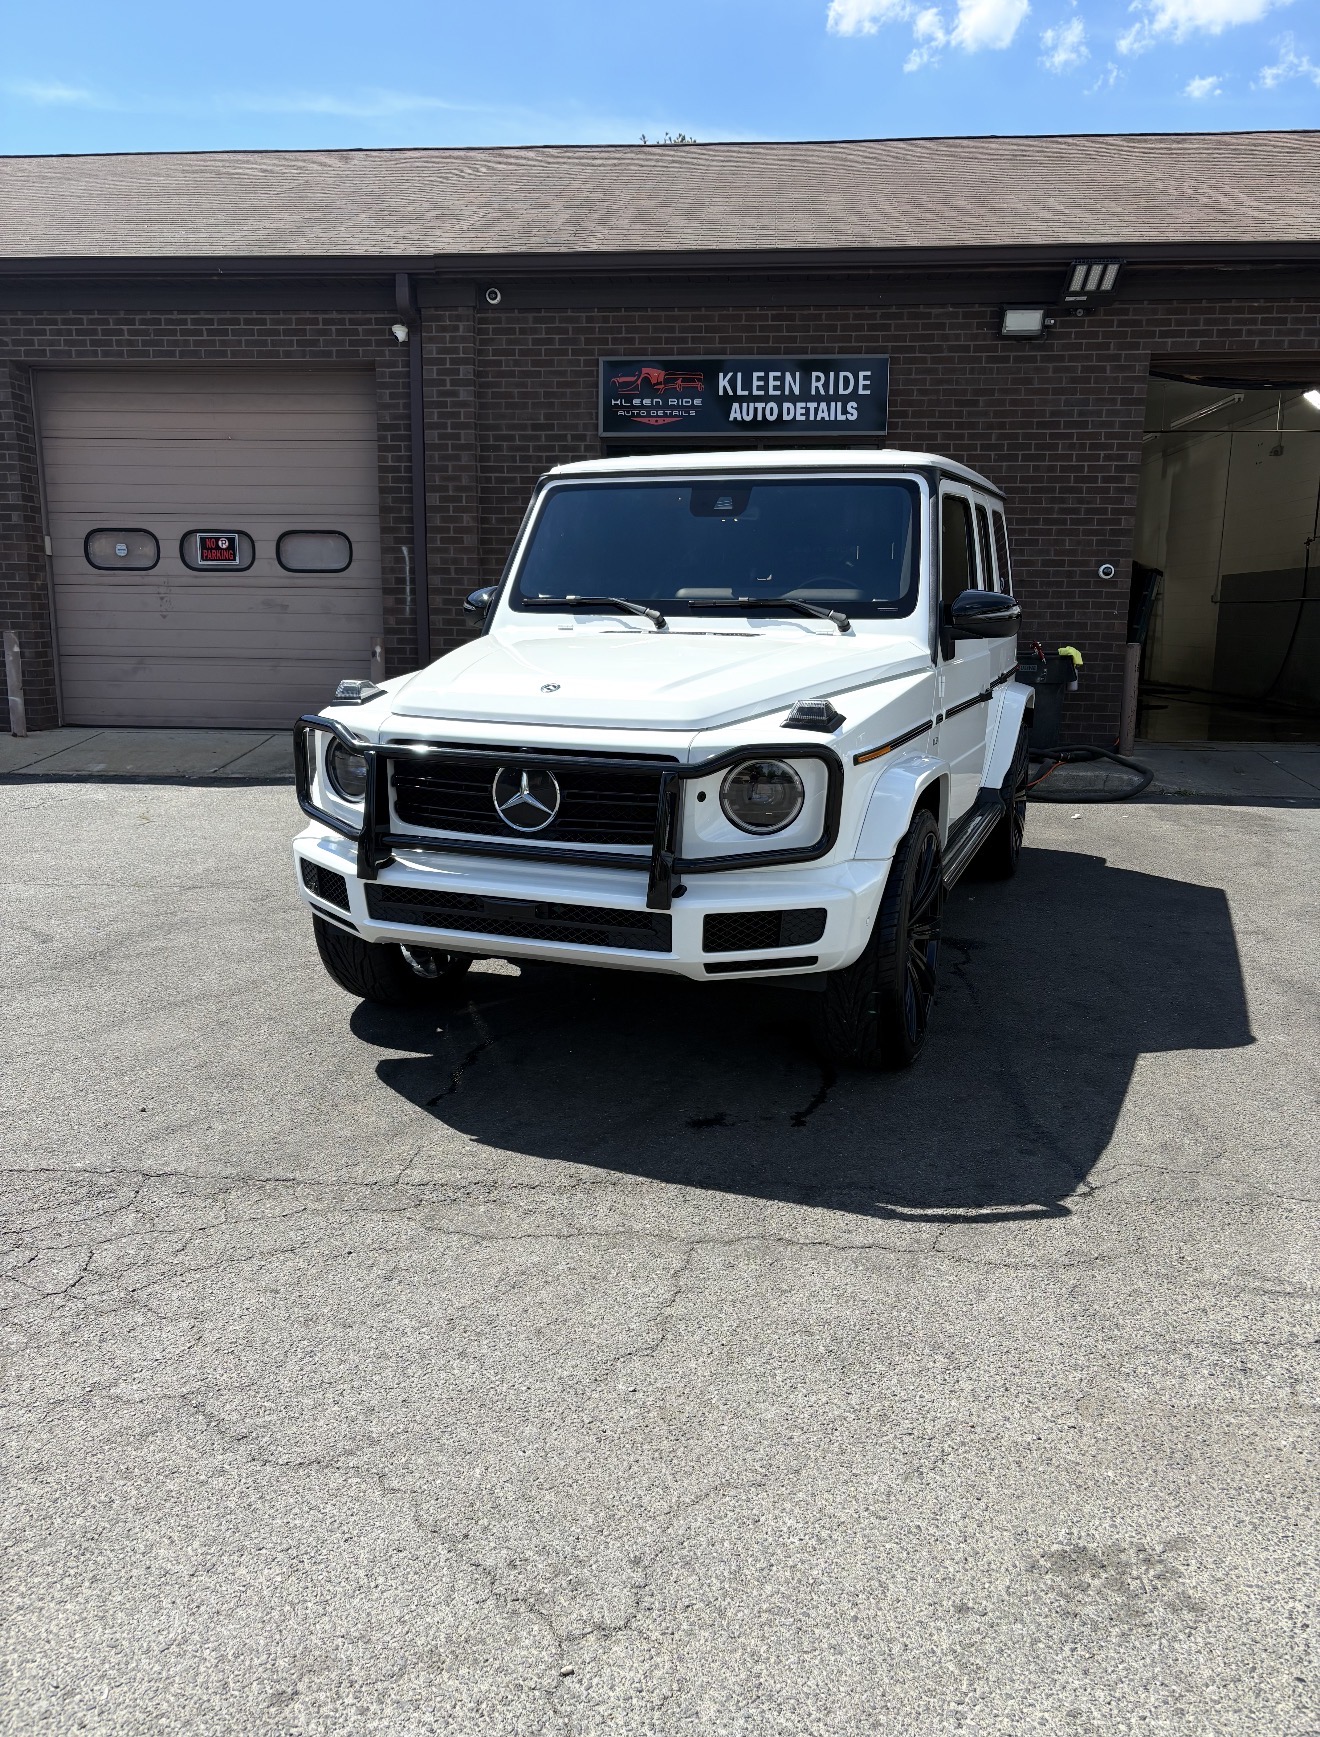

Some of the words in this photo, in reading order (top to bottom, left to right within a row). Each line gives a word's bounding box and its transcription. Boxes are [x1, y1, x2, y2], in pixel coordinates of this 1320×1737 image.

[718, 371, 800, 396] KLEEN
[811, 371, 872, 396] RIDE
[611, 398, 663, 406] KLEEN
[668, 398, 703, 406] RIDE
[729, 401, 779, 421] AUTO
[782, 401, 858, 421] DETAILS
[206, 538, 215, 548] NO
[203, 550, 234, 560] PARKING
